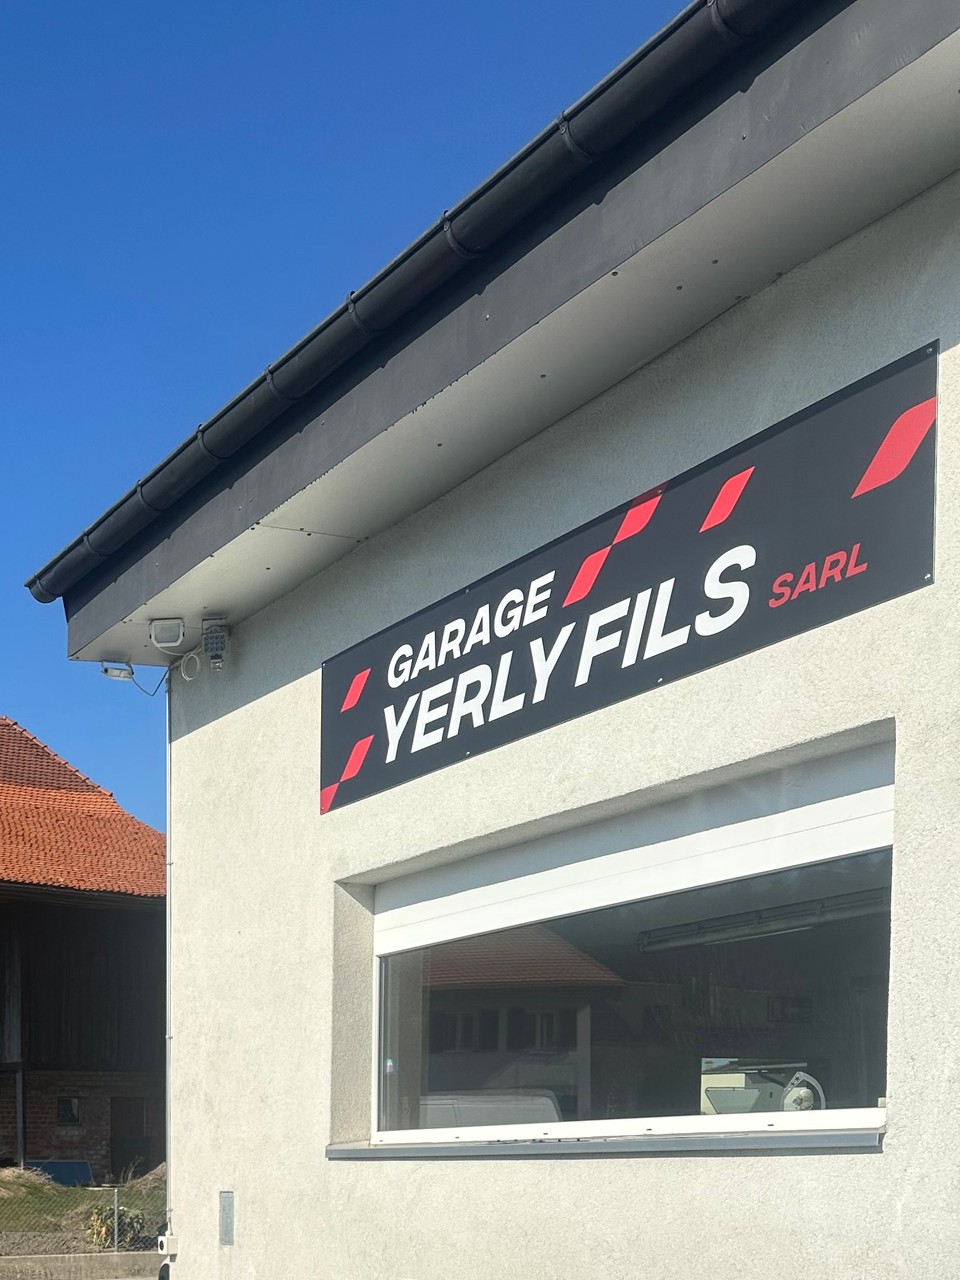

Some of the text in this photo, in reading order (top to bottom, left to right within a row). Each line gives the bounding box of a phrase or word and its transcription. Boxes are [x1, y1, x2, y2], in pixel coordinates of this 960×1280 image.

[382, 543, 869, 764] YERLY FILS SARL
[387, 570, 556, 690] GARAGE
